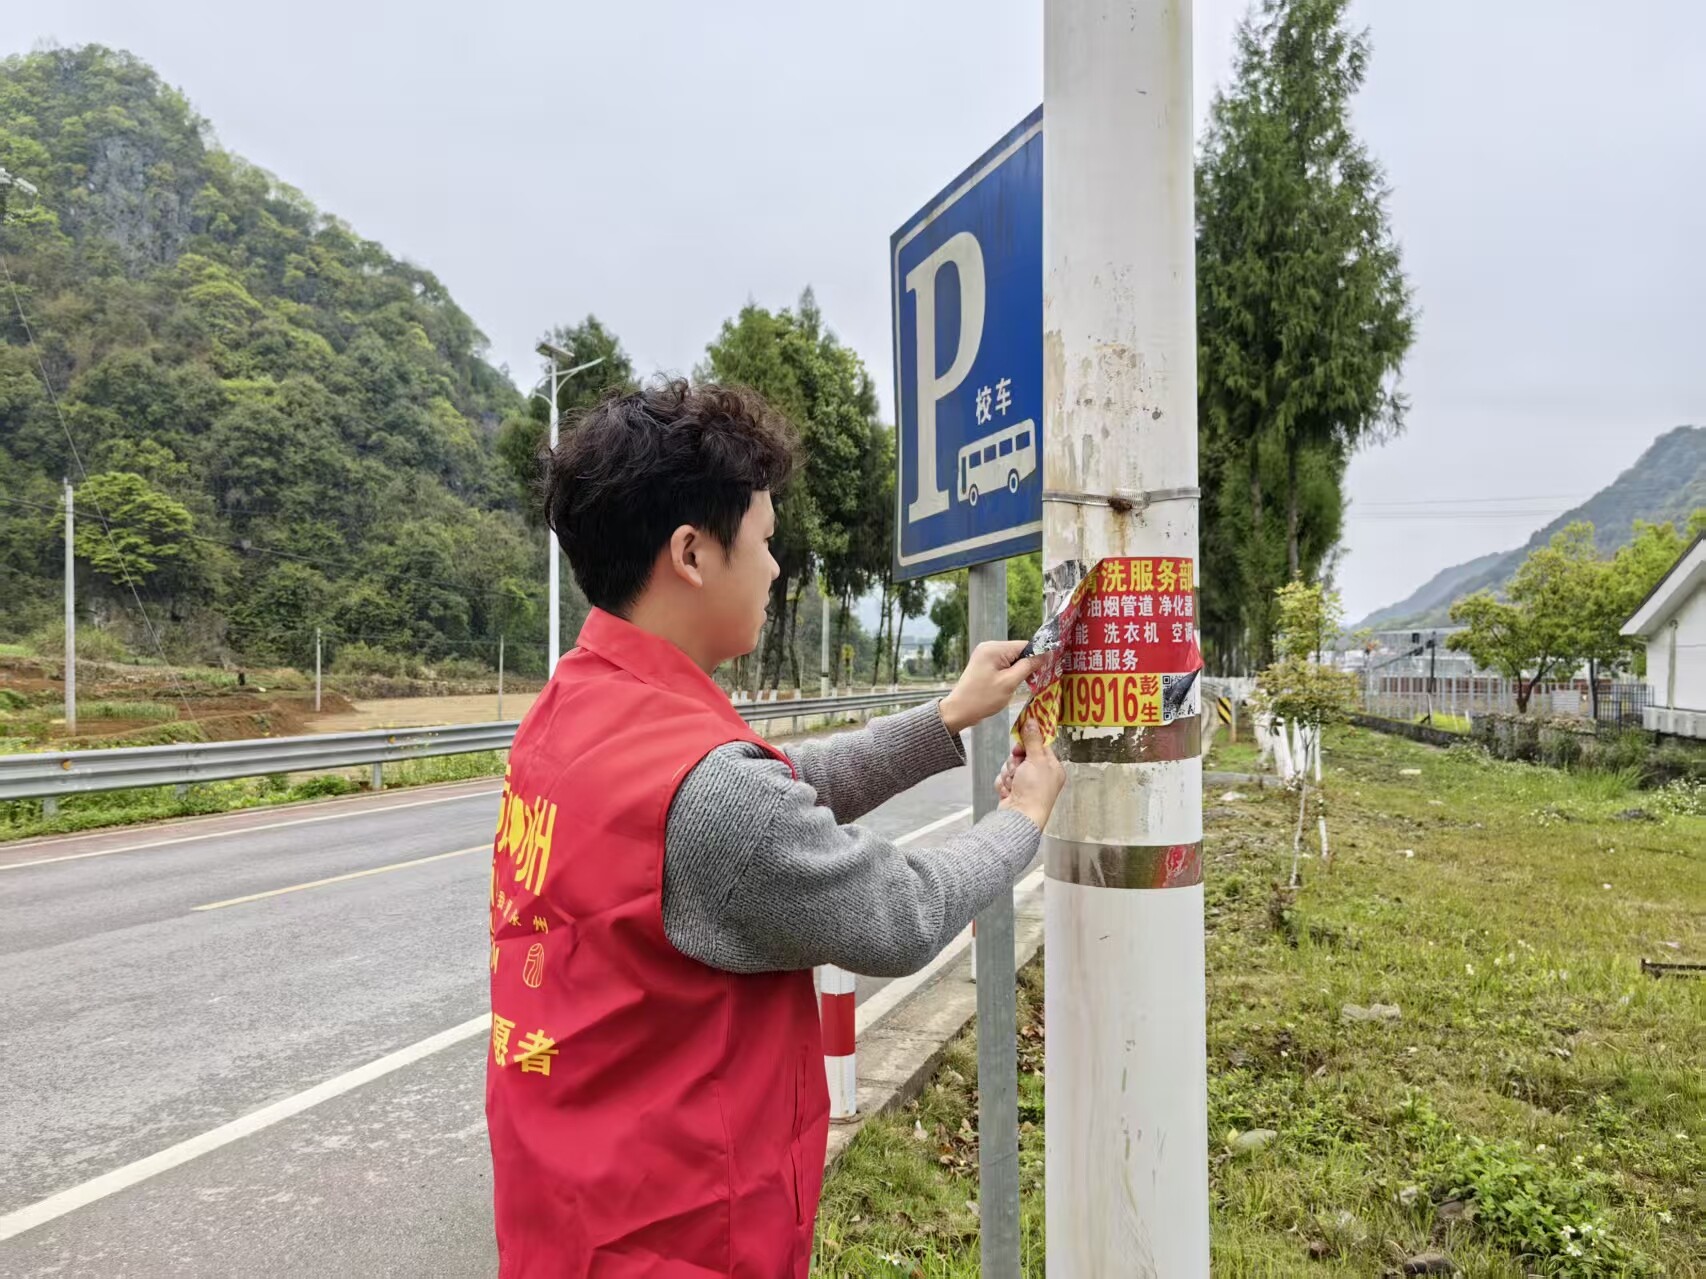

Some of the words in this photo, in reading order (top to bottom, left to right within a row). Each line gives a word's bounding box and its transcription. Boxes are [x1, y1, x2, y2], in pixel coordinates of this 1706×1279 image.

[905, 231, 986, 524] P
[975, 377, 1012, 426] 校车
[1087, 596, 1154, 617] 油烟管道
[1158, 595, 1193, 617] 净化器
[1104, 622, 1160, 644] 洗衣机
